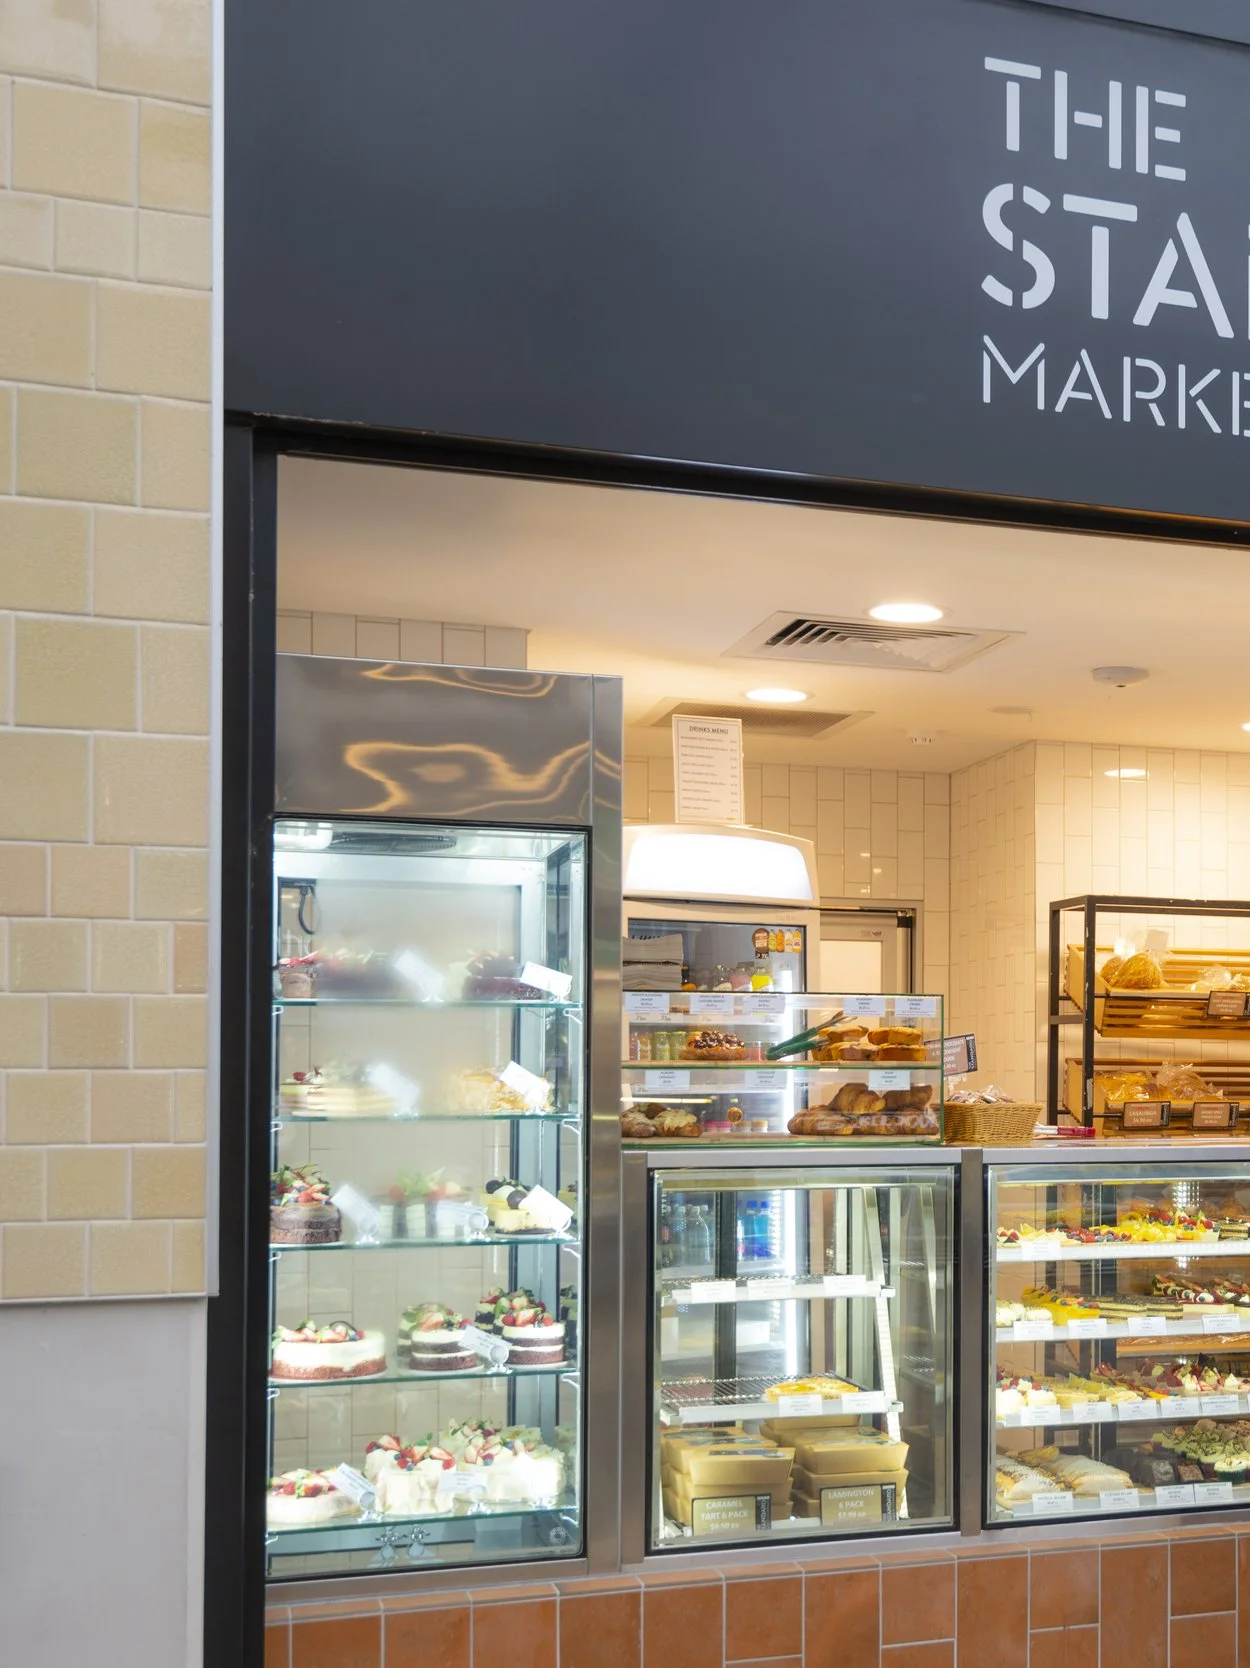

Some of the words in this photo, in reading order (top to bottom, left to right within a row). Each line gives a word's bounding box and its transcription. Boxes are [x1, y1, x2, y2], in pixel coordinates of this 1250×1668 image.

[984, 56, 1187, 182] THE
[689, 725, 711, 733] DRINKS
[828, 1488, 874, 1500] LAMINGTON
[706, 1500, 743, 1510] CARAMEL
[845, 1500, 865, 1508] PACK
[700, 1512, 721, 1520] TART
[728, 1510, 749, 1518] PACK
